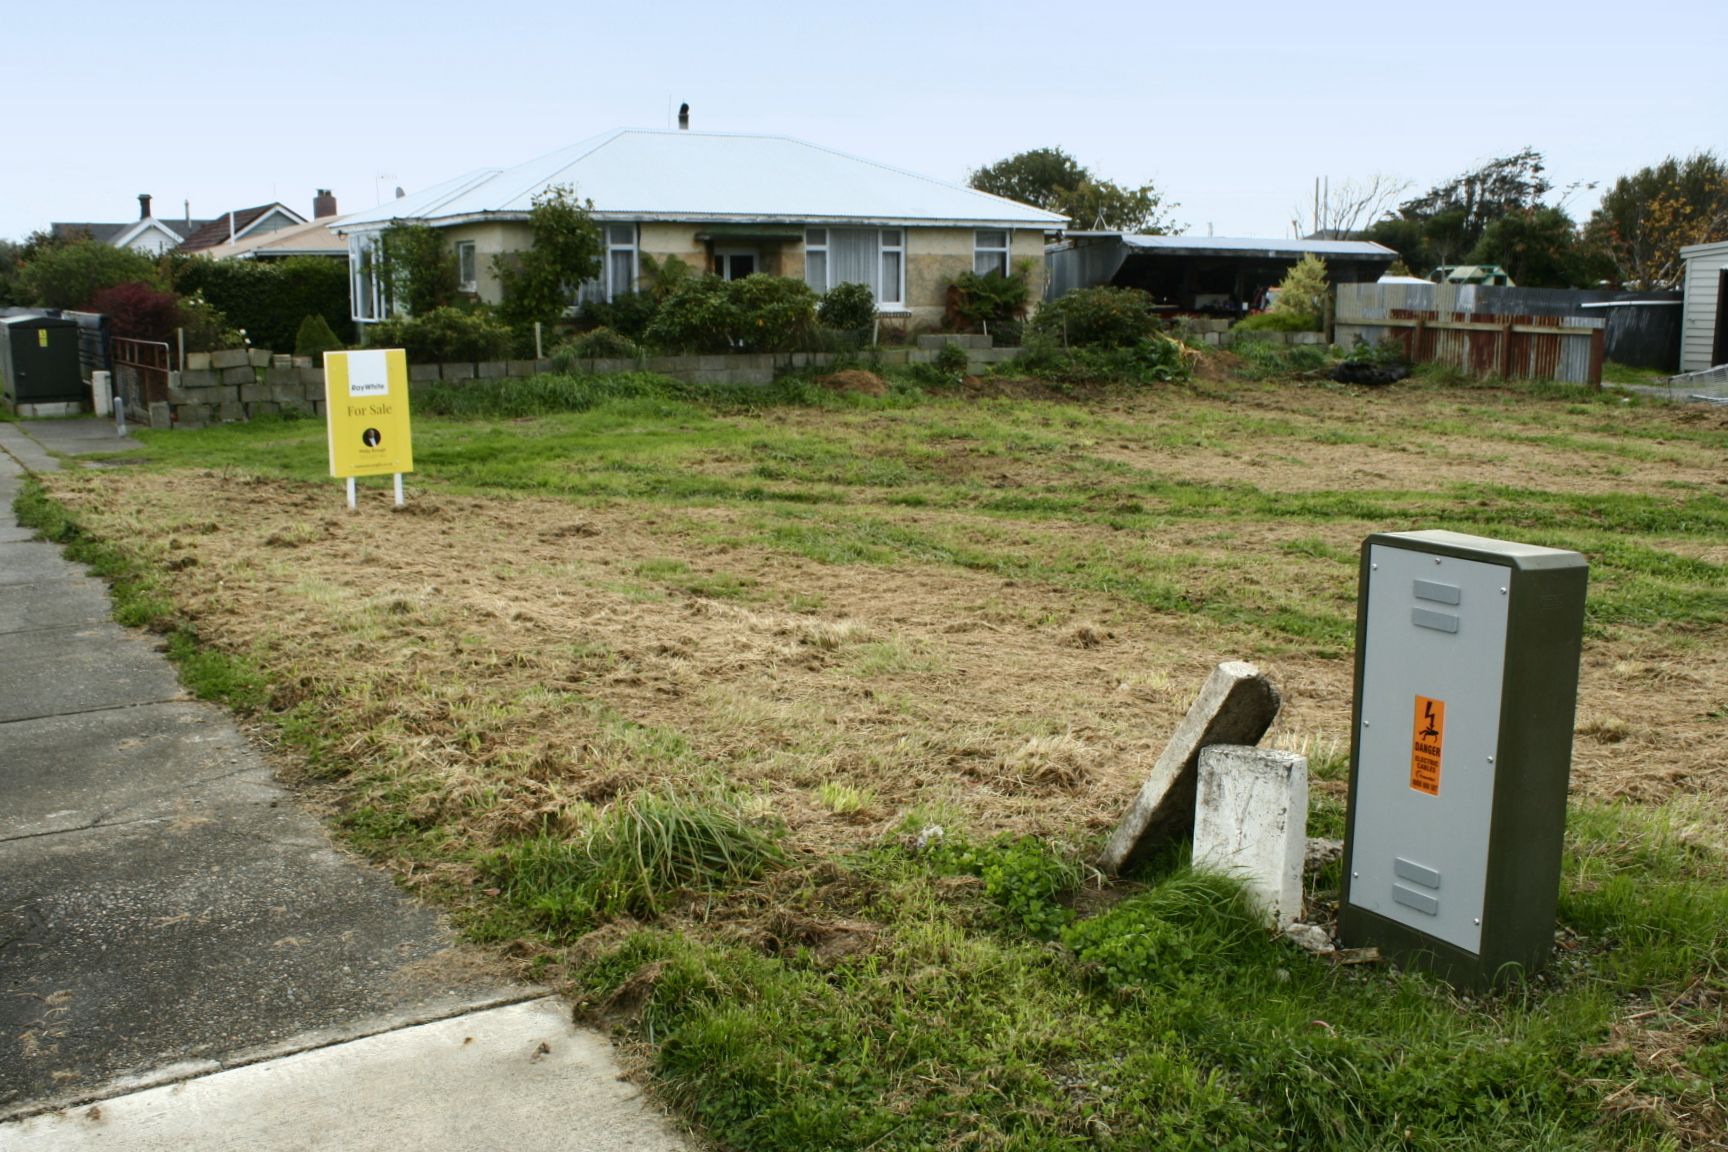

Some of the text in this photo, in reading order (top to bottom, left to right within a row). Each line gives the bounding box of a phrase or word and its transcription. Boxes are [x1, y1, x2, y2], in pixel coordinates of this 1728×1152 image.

[347, 402, 392, 417] For Sale
[1415, 741, 1441, 757] DANGER
